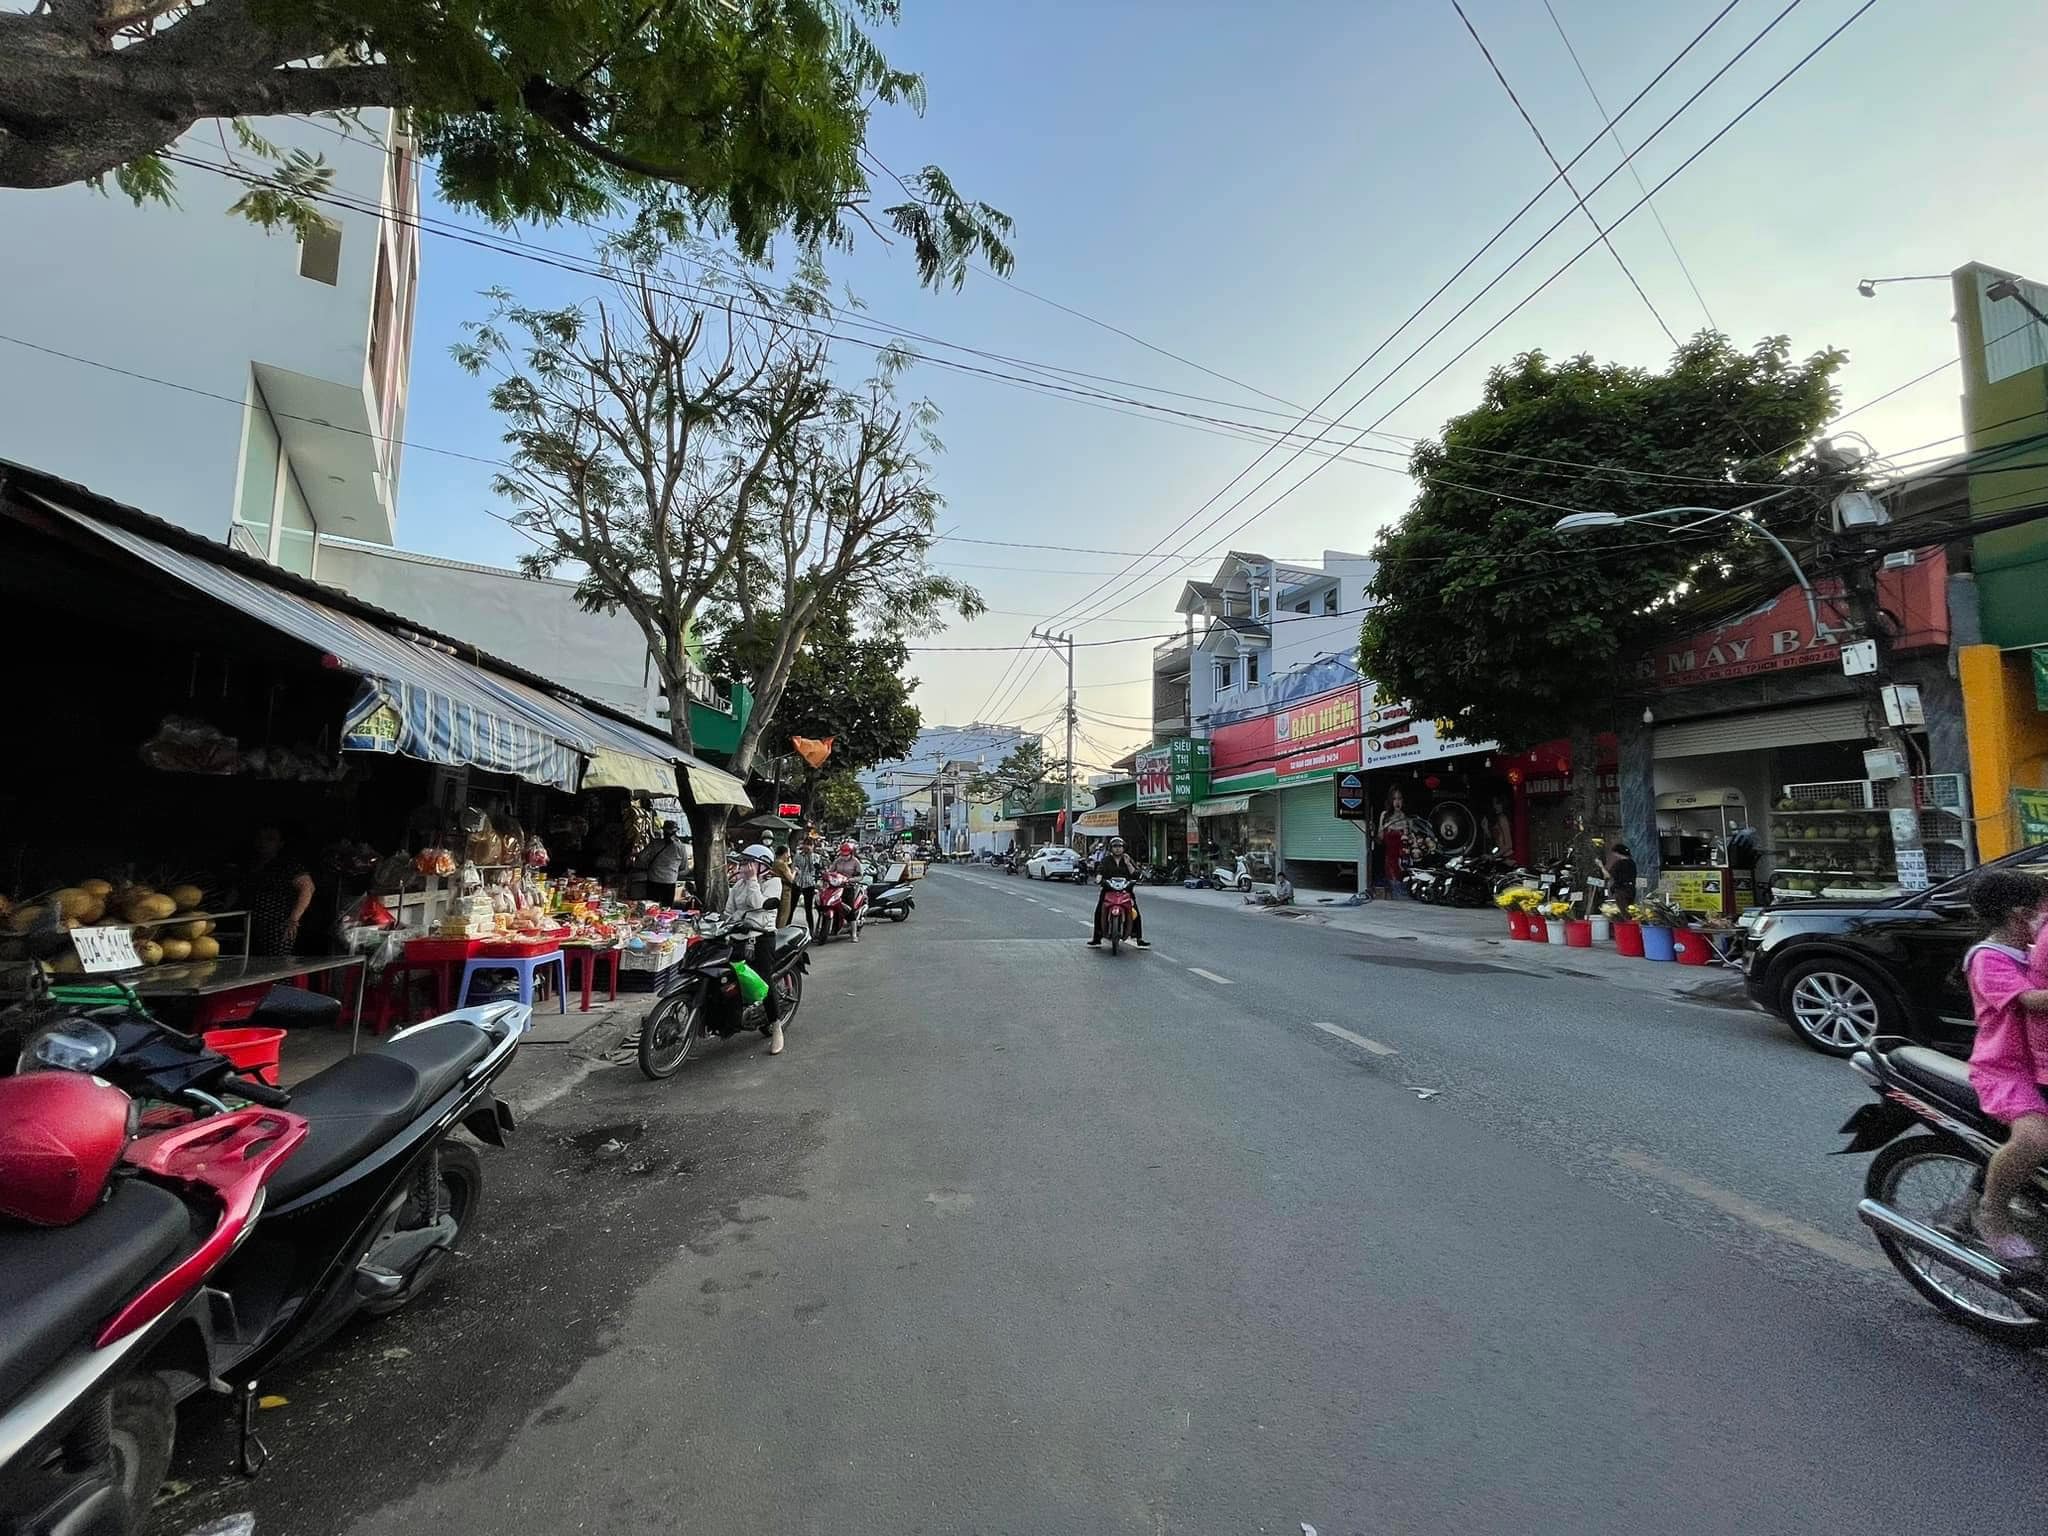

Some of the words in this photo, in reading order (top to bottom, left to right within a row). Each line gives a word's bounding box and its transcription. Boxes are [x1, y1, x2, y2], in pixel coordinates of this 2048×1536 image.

[1666, 630, 1754, 675] MÁY
[1174, 740, 1191, 751] SIÊU
[1177, 754, 1189, 766] THỊ
[1175, 784, 1191, 795] NON
